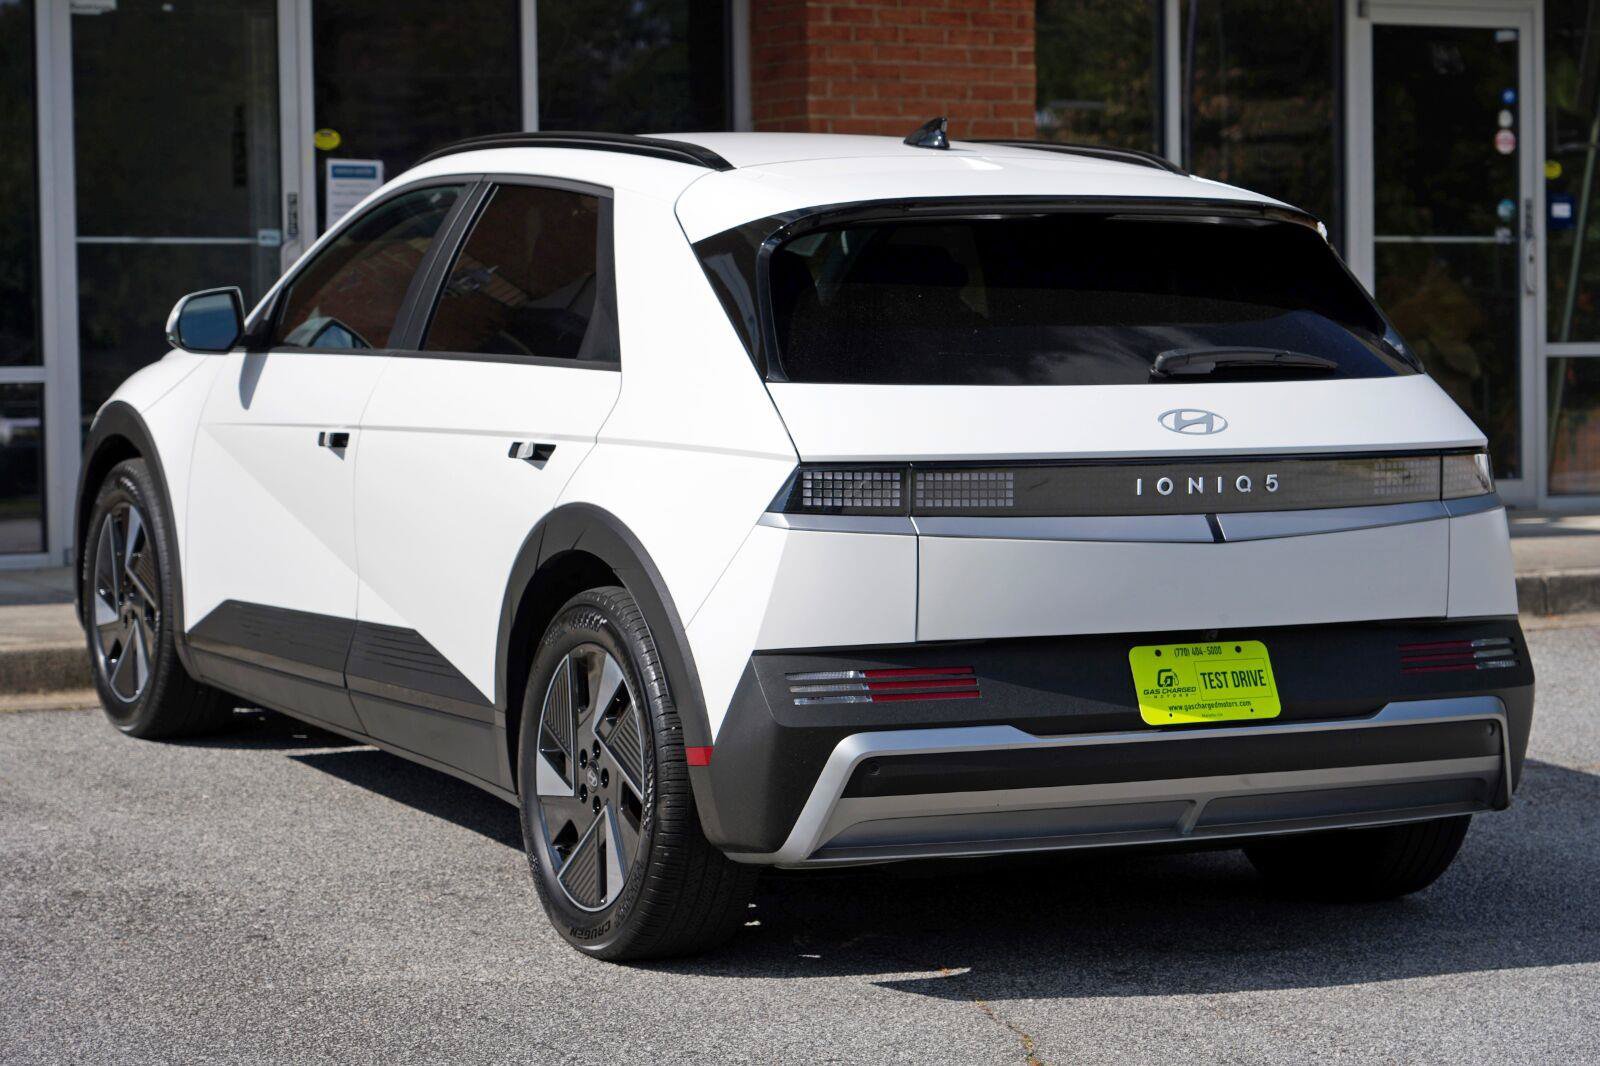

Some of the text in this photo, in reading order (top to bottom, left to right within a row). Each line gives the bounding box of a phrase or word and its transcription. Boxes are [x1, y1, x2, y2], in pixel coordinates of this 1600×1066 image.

[1200, 669, 1266, 690] TEST DRIVE
[1168, 701, 1251, 711] www.gaschargedmotors.com
[569, 920, 611, 940] CRUGEN
